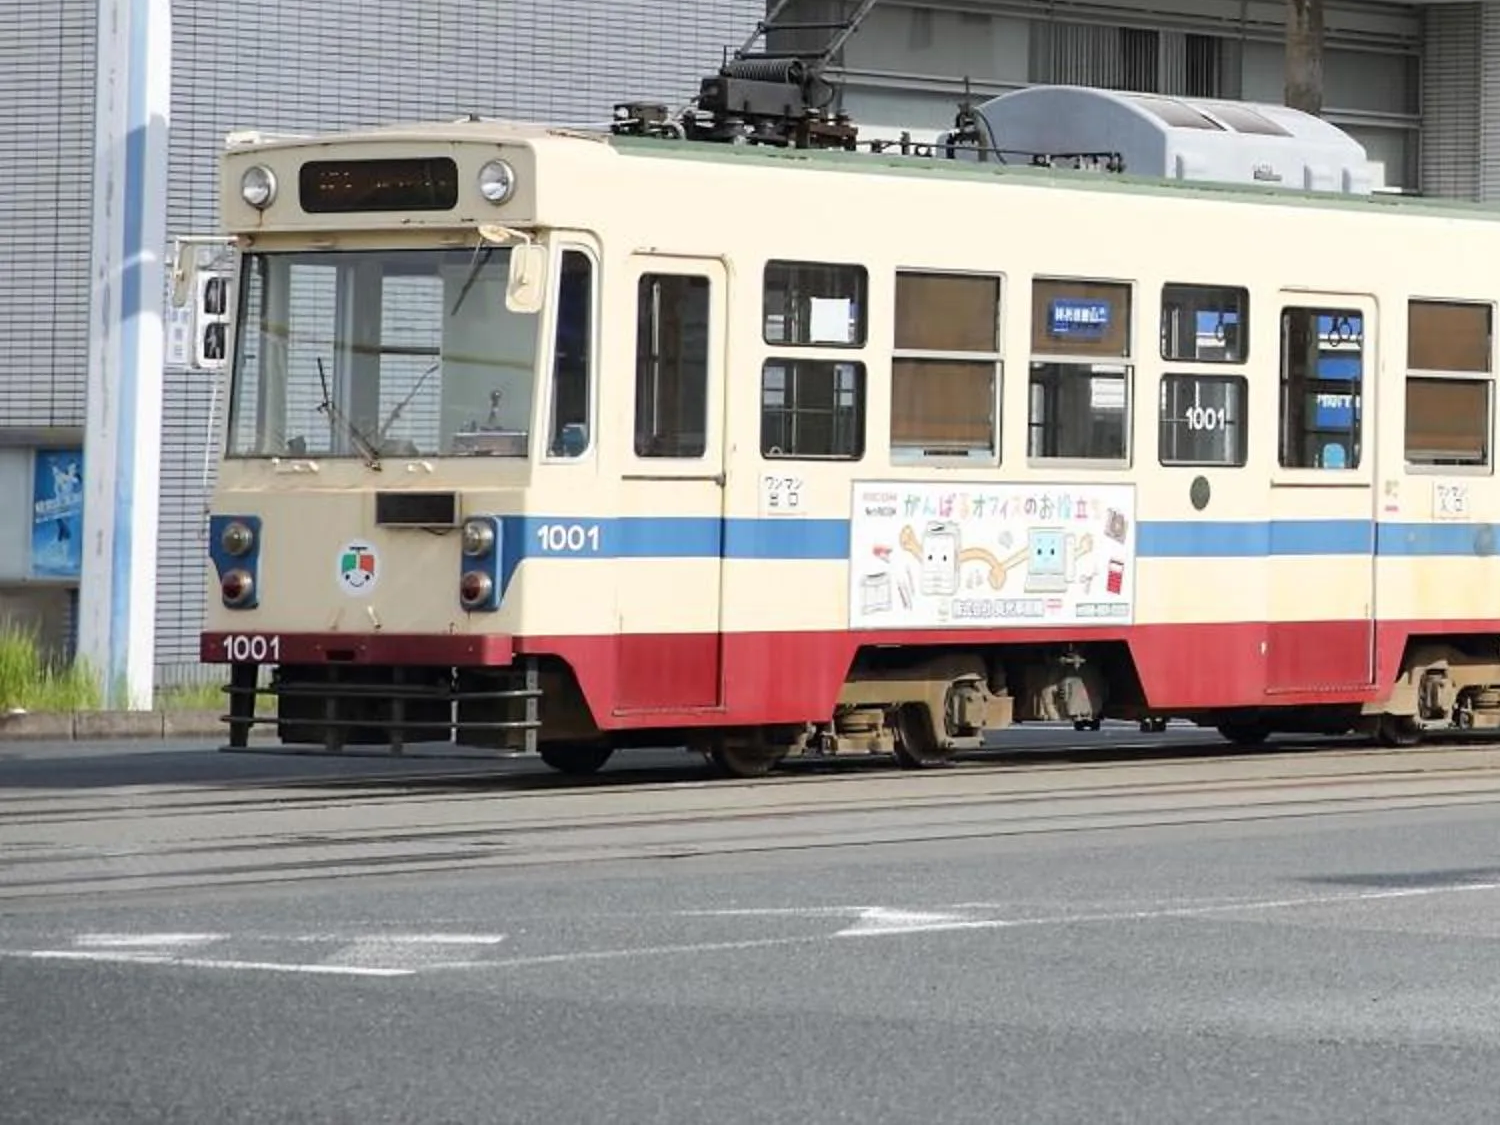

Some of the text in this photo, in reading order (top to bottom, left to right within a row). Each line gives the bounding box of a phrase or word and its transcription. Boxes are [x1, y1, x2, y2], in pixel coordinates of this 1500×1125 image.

[1185, 407, 1226, 430] 1001
[764, 476, 804, 491] ワンマン
[768, 491, 799, 507] 出口
[537, 524, 600, 551] 1001
[223, 634, 279, 661] 1001
